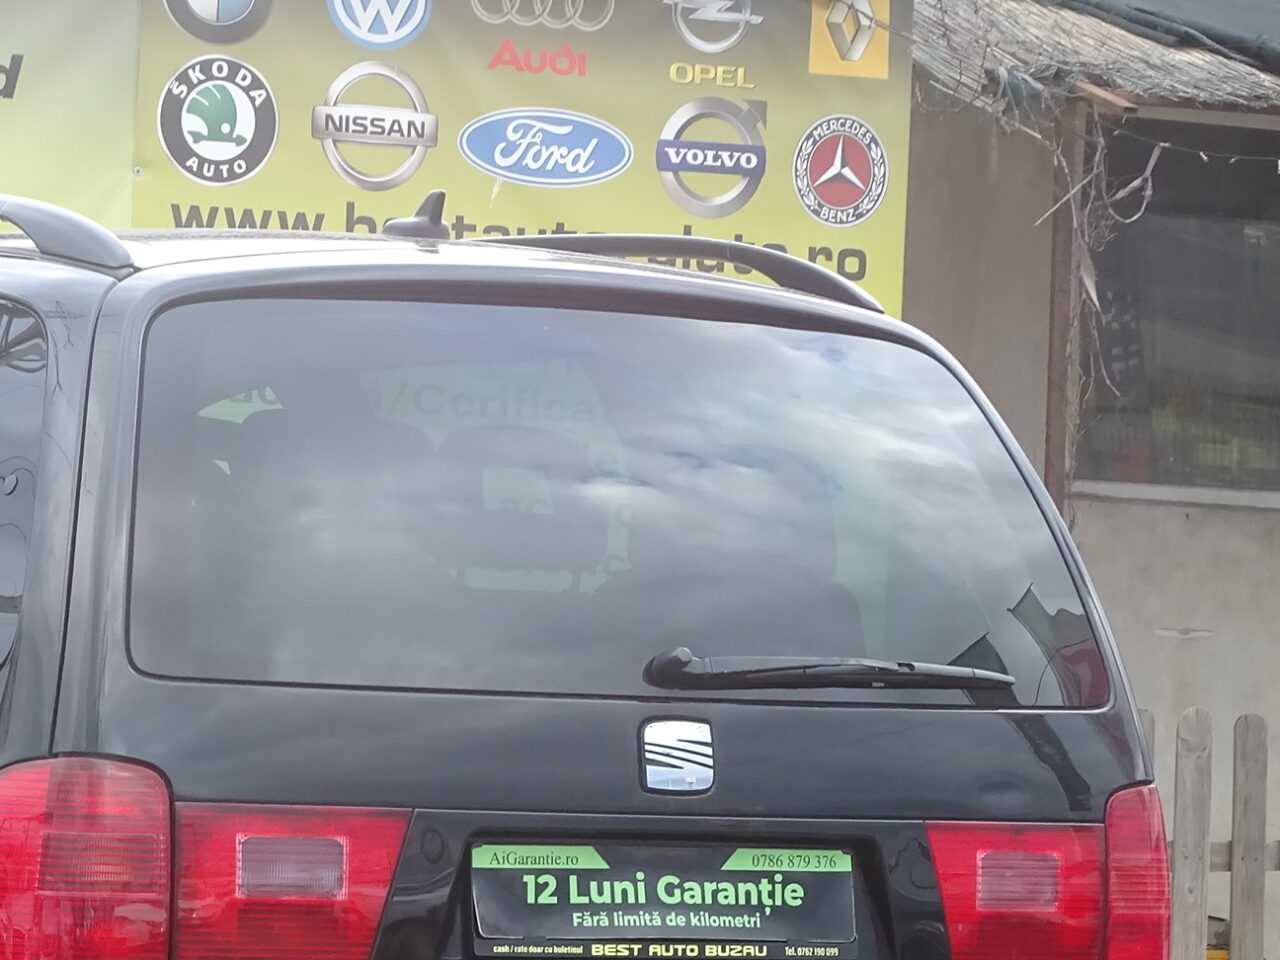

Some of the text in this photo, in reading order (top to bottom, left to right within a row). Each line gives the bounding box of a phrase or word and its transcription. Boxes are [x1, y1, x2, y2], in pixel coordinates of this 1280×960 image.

[487, 38, 587, 77] Audi
[669, 62, 756, 89] OPEL
[324, 113, 426, 139] NISSAN
[812, 118, 873, 145] MERCEDES
[493, 118, 598, 174] Ford
[664, 145, 758, 170] VOLVO
[185, 156, 247, 179] AUTO
[820, 206, 856, 223] BENZ
[489, 851, 579, 866] AiGarantie.ro
[751, 854, 837, 869] 0786 879 376
[522, 871, 805, 916] 12 Luni Garanție
[573, 910, 761, 928] Fără limită de kilometri
[591, 943, 642, 956] BEST
[648, 943, 698, 956] AUTO
[705, 944, 768, 957] BUZAU
